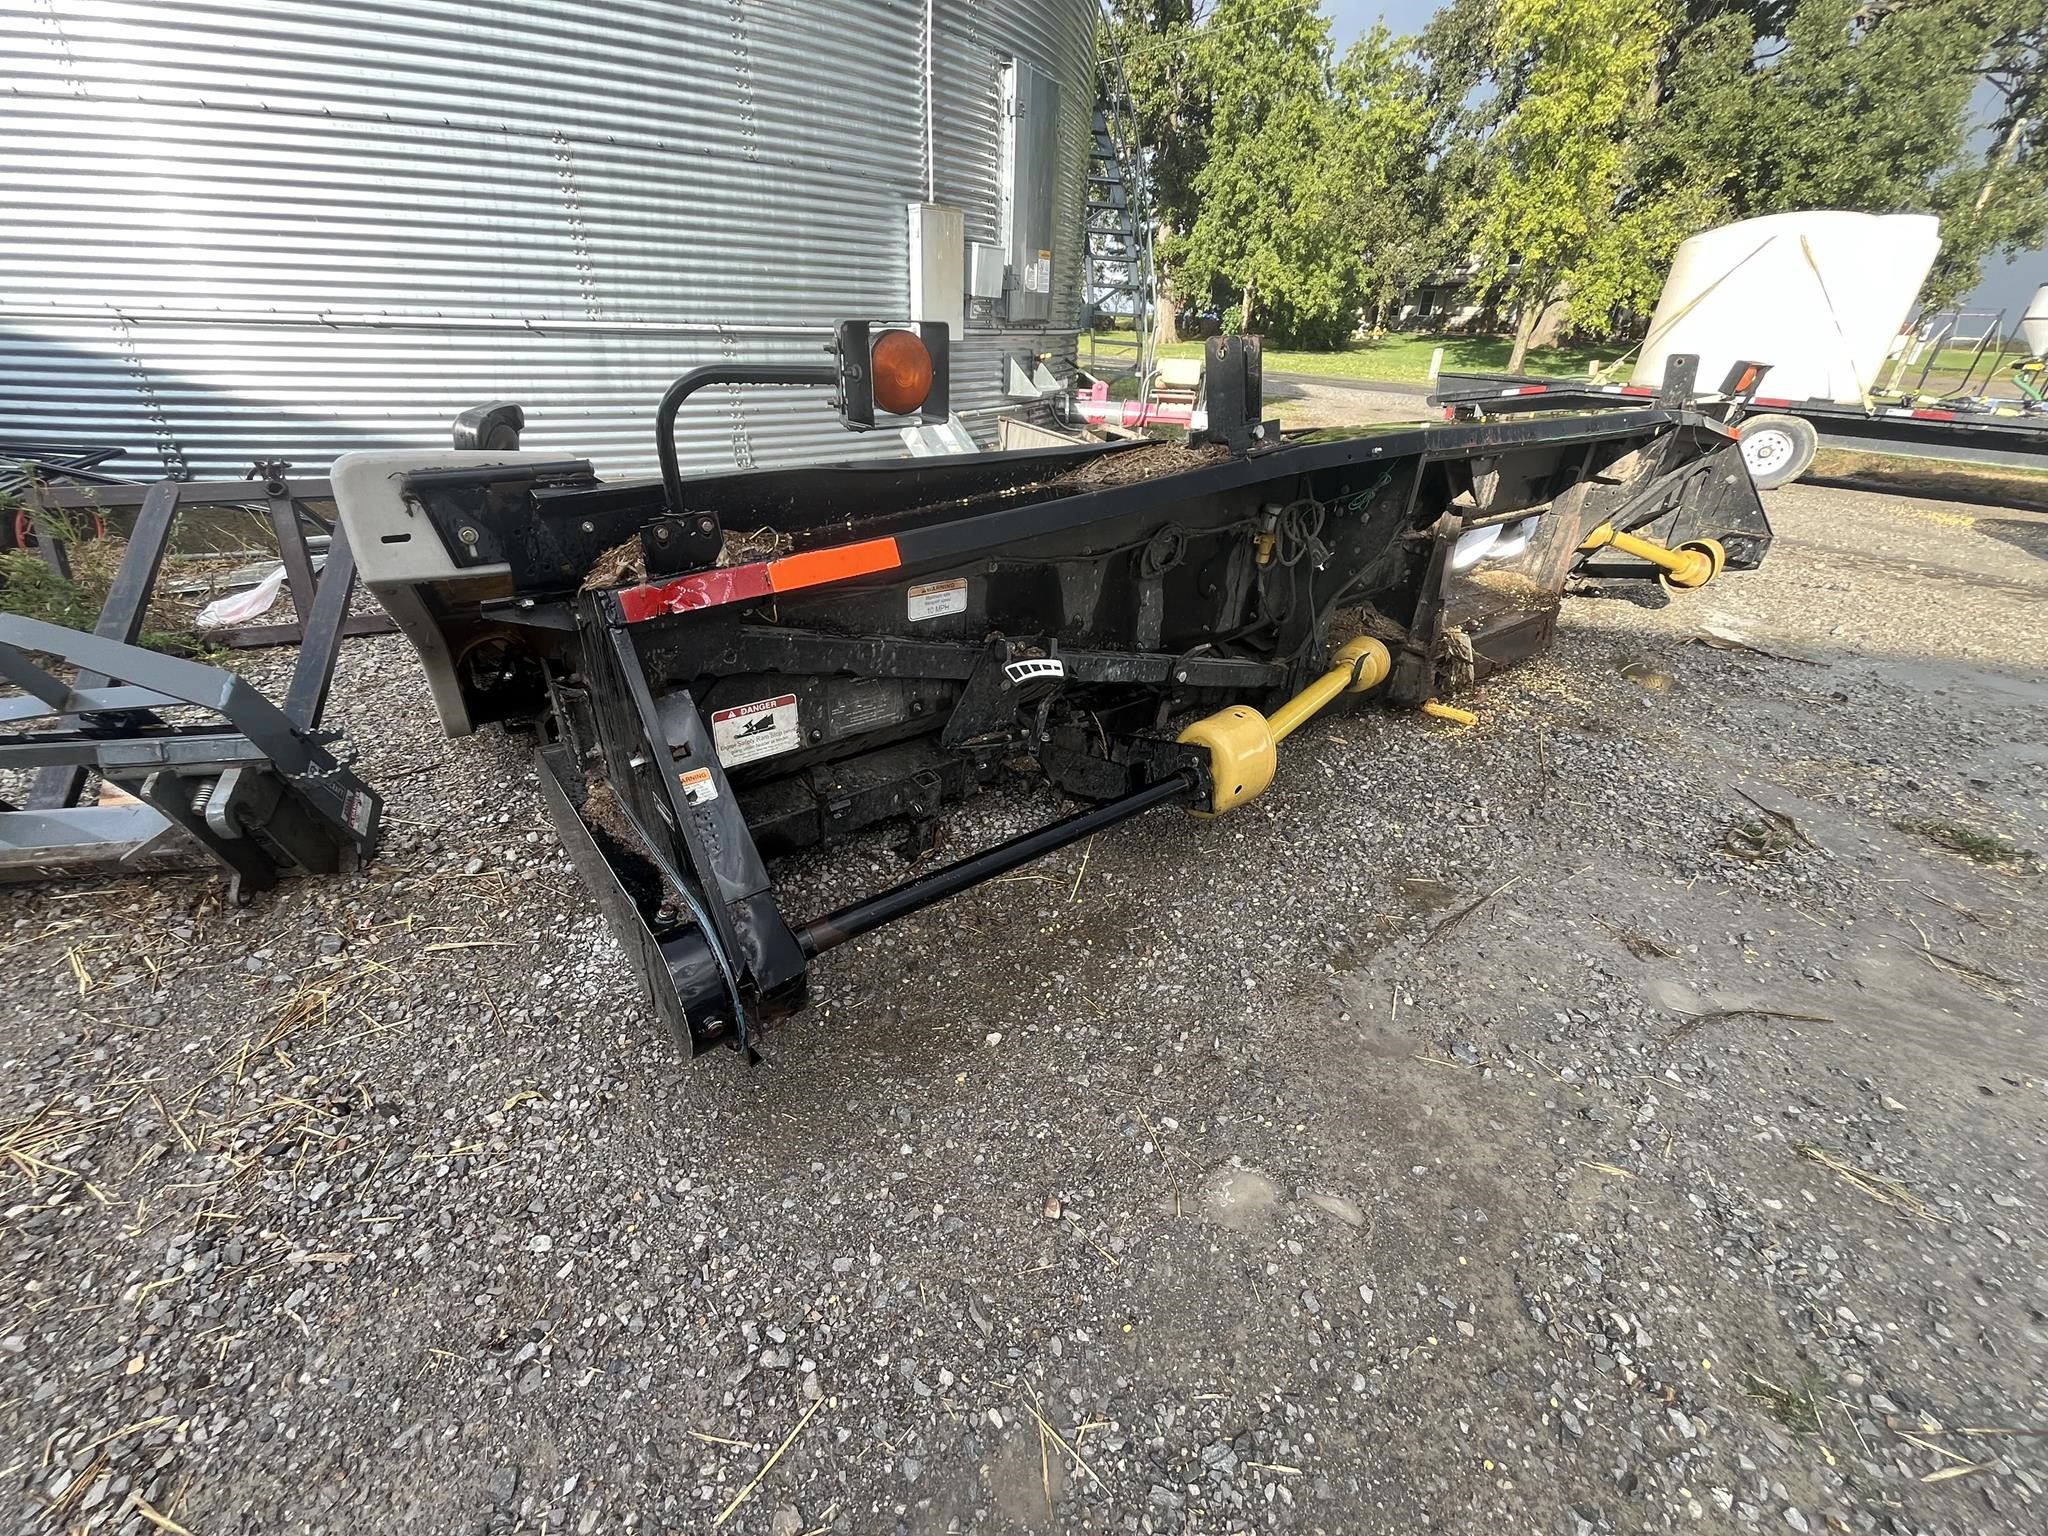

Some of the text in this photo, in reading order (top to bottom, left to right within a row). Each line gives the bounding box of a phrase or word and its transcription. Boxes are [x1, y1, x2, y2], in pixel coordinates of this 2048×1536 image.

[927, 583, 955, 592] WARNING
[928, 604, 949, 614] 10 MPH
[740, 700, 777, 715] DANGER
[681, 772, 706, 783] ARNING
